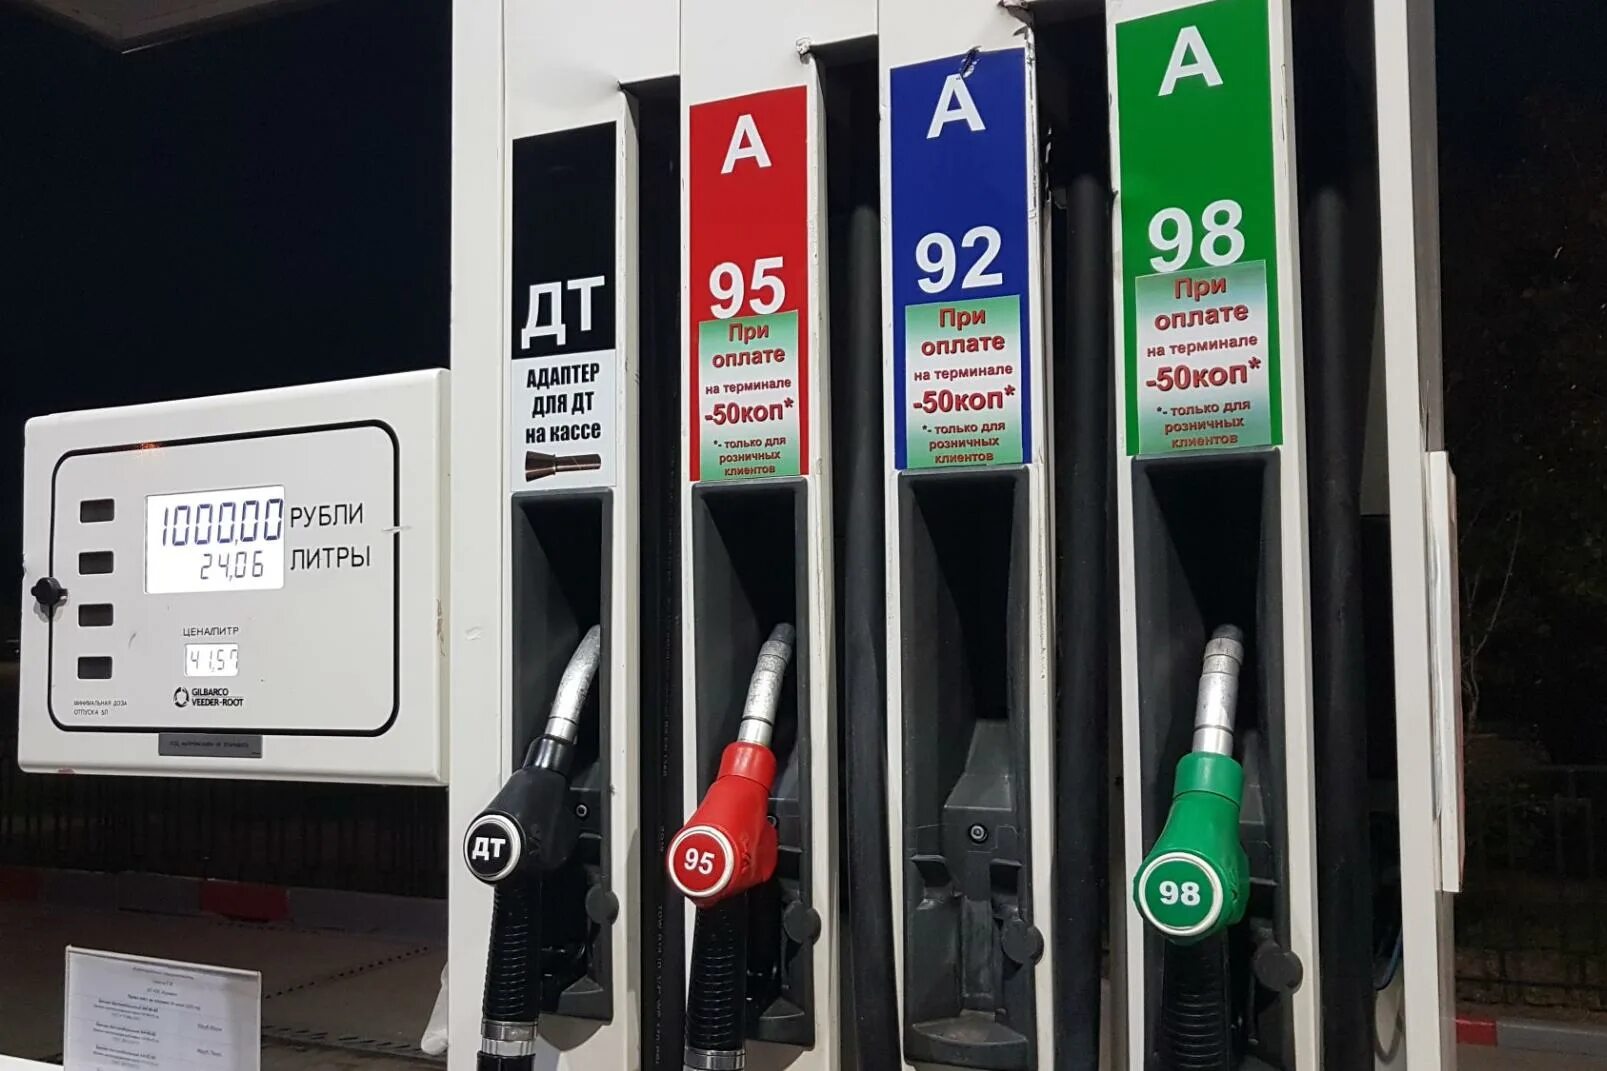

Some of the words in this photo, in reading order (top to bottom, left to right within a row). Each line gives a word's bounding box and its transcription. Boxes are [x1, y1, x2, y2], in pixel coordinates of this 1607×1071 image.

[1148, 199, 1245, 273] 98
[915, 225, 1003, 294] 92
[708, 256, 786, 319] 95
[1174, 277, 1227, 301] При
[521, 275, 605, 349] ДТ
[939, 307, 986, 331] При
[1154, 304, 1249, 331] оплате
[728, 322, 769, 345] При
[921, 335, 1006, 357] оплате
[1147, 345, 1165, 358] на
[1169, 334, 1258, 356] терминале
[712, 347, 786, 369] оплате
[526, 363, 600, 390] АДАПТЕР
[914, 371, 931, 382] на
[934, 364, 1013, 382] терминале
[705, 385, 720, 395] на
[723, 377, 792, 396] терминале
[532, 393, 567, 418] ДЛЯ
[571, 391, 595, 414] ДТ
[1170, 403, 1219, 417] только
[1223, 400, 1251, 414] для
[525, 426, 546, 444] на
[551, 422, 602, 442] кассе
[934, 423, 978, 435] только
[981, 421, 1006, 433] для
[1164, 417, 1244, 435] розничных
[724, 438, 762, 449] только
[765, 436, 787, 448] для
[929, 437, 1000, 451] розничных
[1171, 434, 1238, 448] клиентов
[719, 449, 781, 464] розничных
[934, 451, 994, 464] клиентов
[724, 464, 776, 476] клиентов
[162, 498, 284, 546] 1000,00
[290, 503, 363, 528] РУБЛИ
[200, 550, 264, 581] 24,06
[290, 545, 371, 570] ЛИТРЫ
[191, 688, 229, 696] GILBARCO
[191, 698, 244, 706] VEEDER-ROOT
[471, 836, 506, 861] ДТ
[683, 847, 715, 875] 95
[1159, 880, 1201, 906] 98
